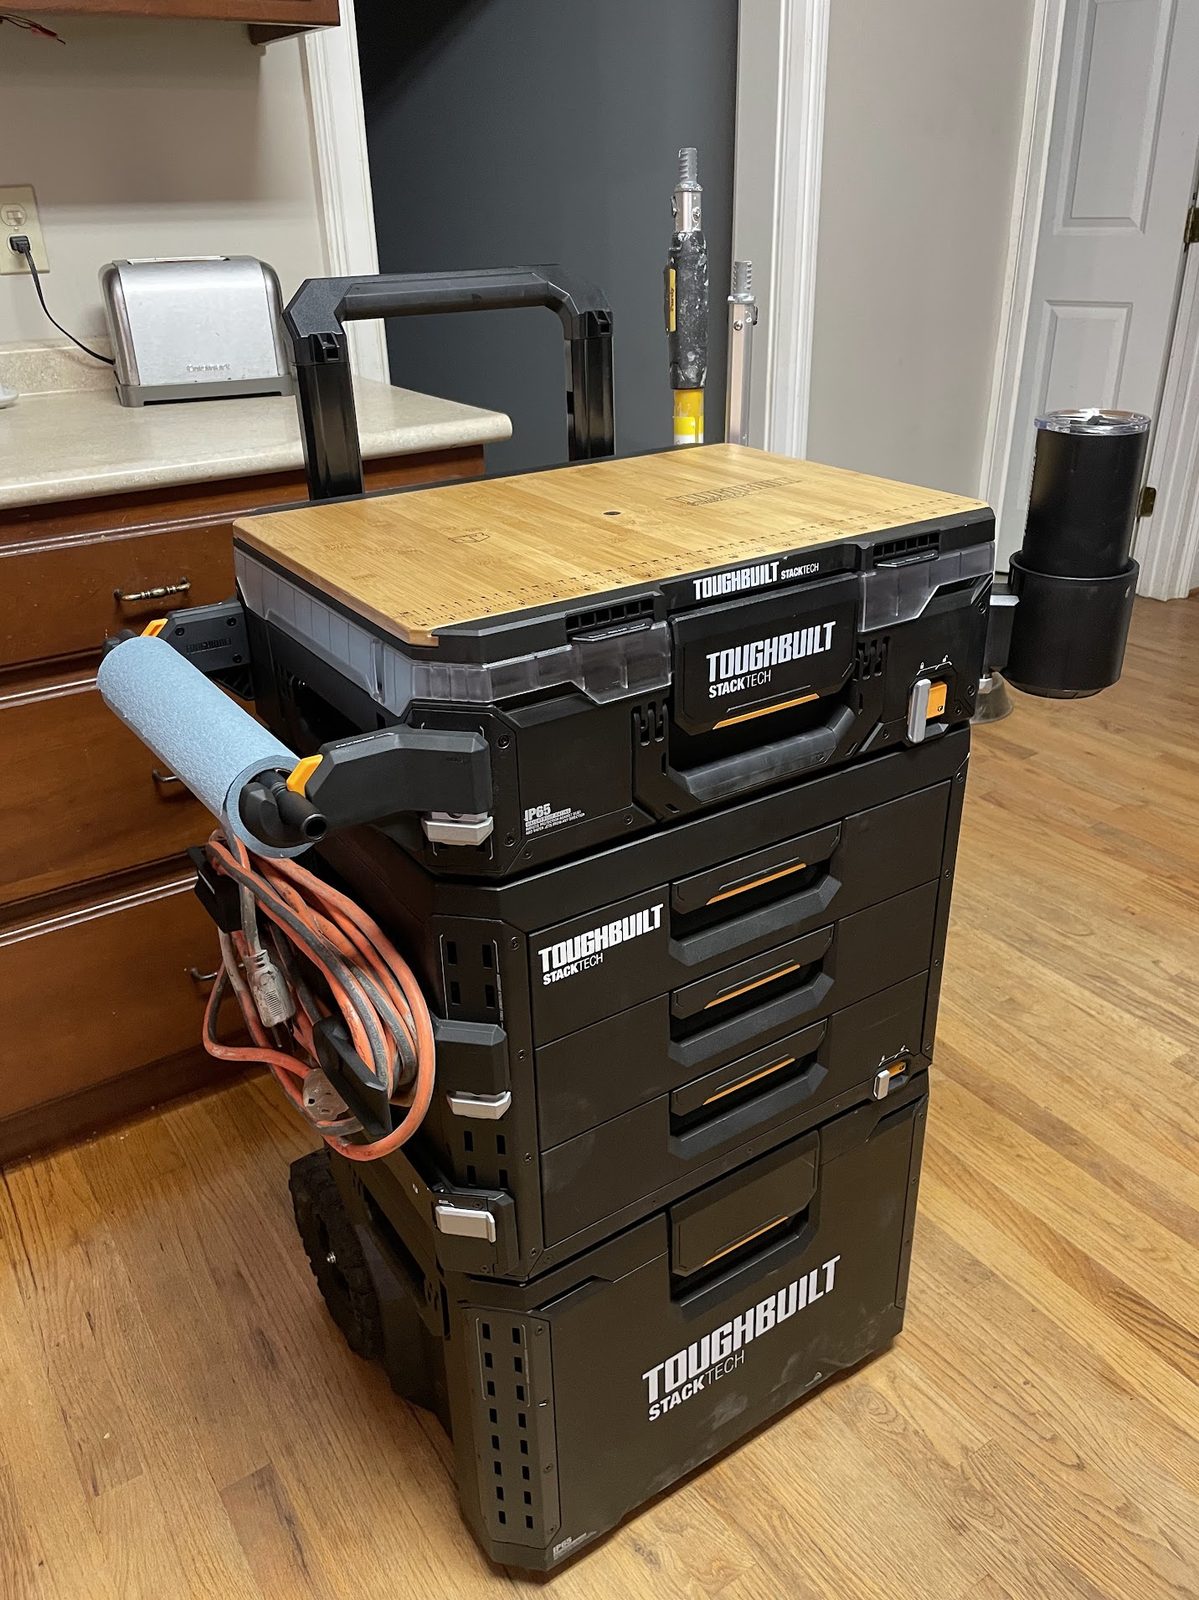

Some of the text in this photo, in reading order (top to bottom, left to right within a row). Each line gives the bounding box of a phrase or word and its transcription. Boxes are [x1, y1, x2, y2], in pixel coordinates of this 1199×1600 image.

[693, 561, 820, 601] TOUGHBUILT STACKTECH
[706, 621, 837, 682] TOUGHBUILT
[708, 669, 772, 699] STACKTECH
[524, 803, 552, 822] IP65
[538, 903, 664, 973] TOUGHBUILT
[542, 952, 604, 986] STACKTECH
[642, 1255, 841, 1404] TOUGHBUILT
[648, 1350, 745, 1422] STACKTECH
